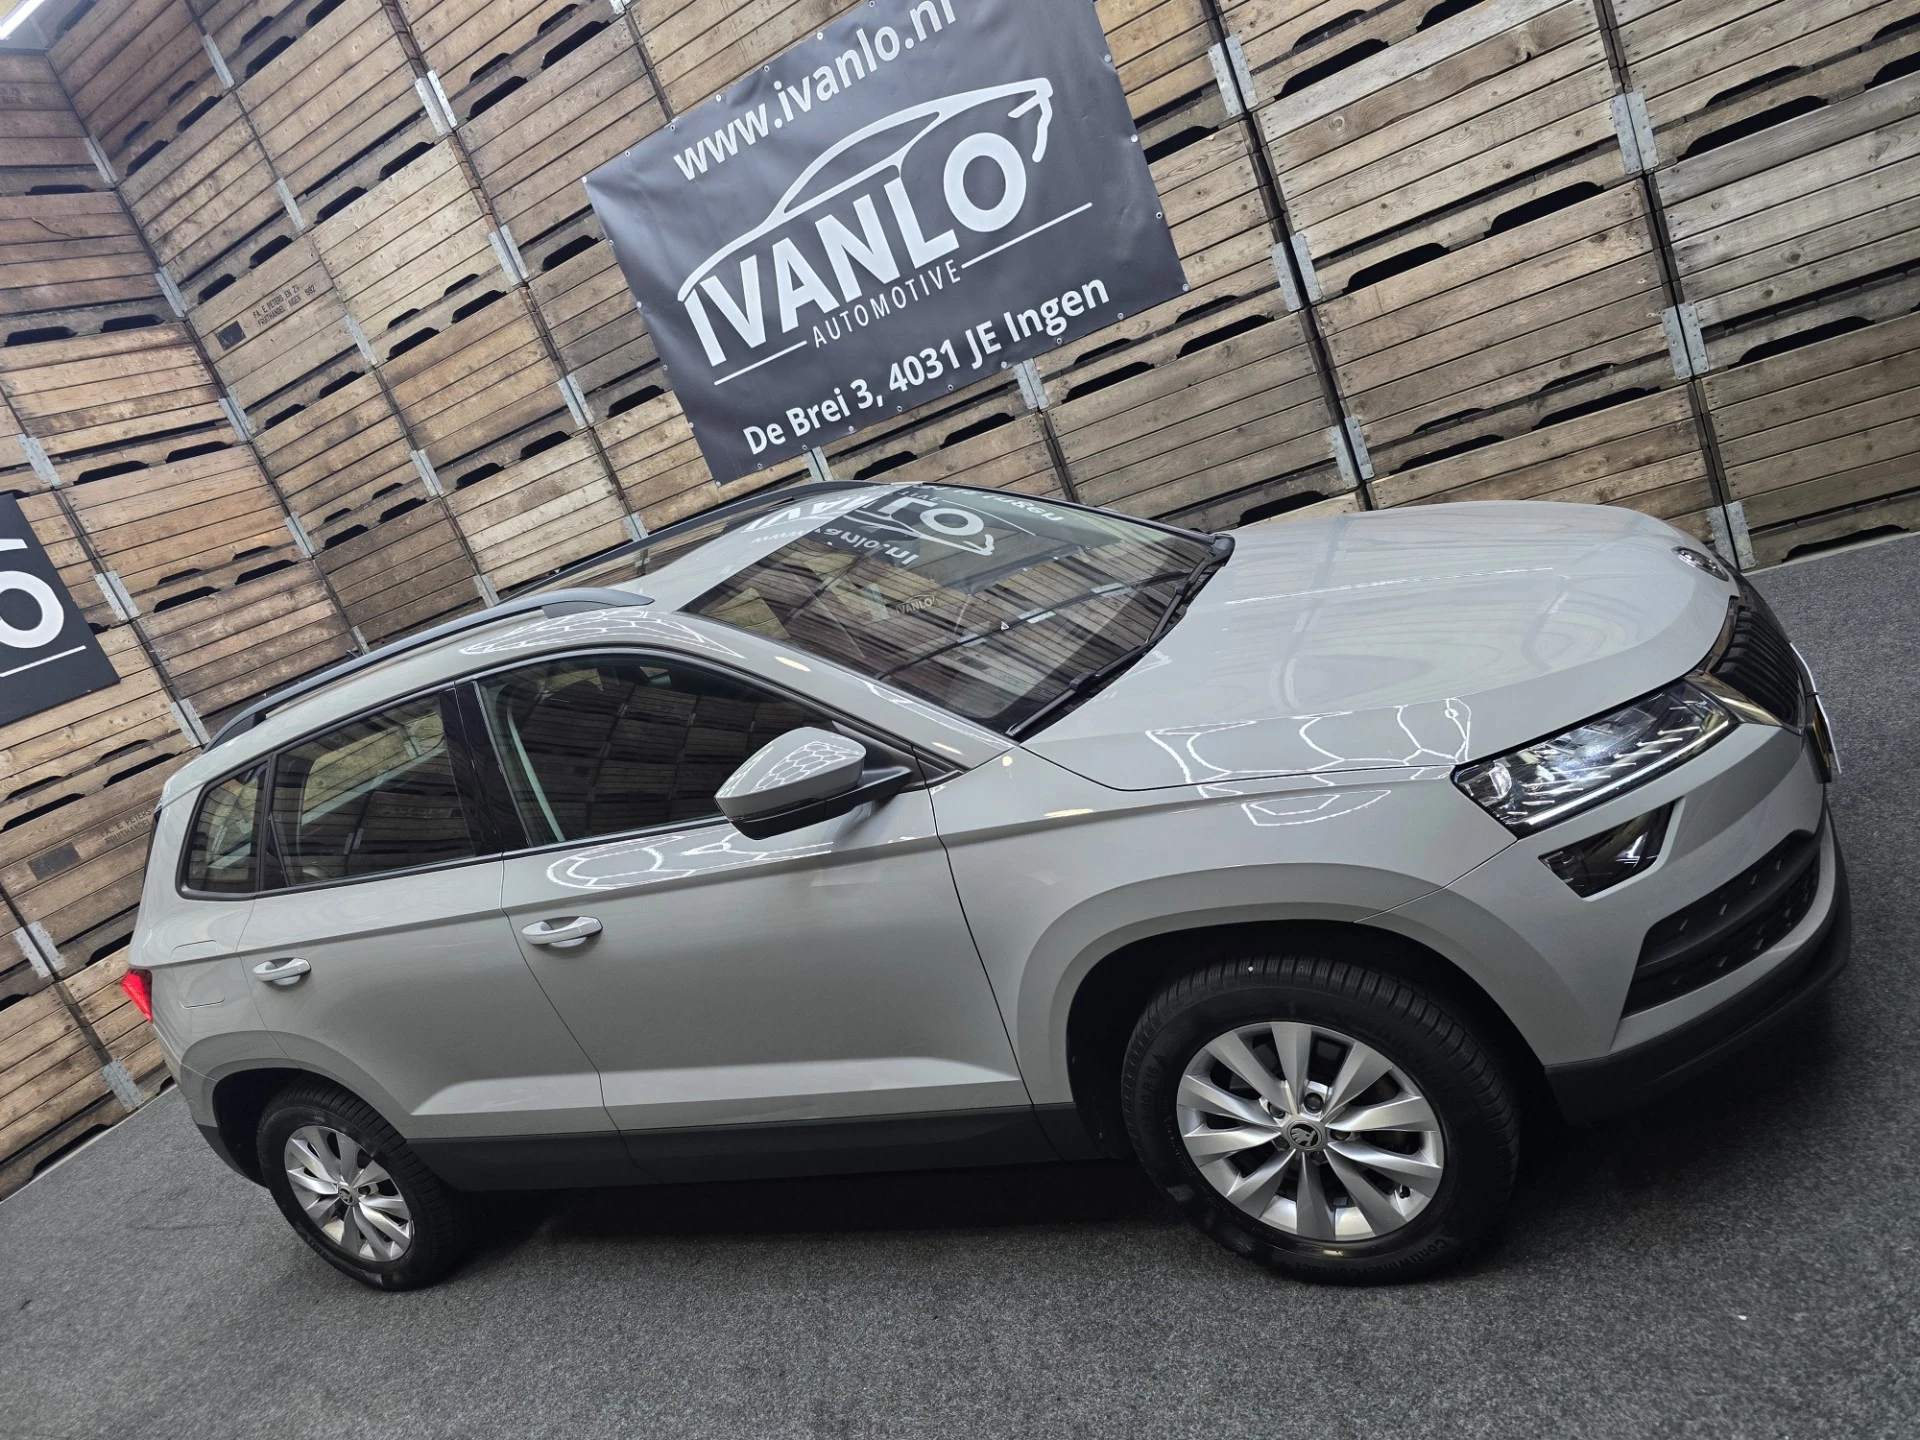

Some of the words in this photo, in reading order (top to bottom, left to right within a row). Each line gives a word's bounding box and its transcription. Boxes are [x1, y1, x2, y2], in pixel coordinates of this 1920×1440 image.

[683, 132, 1027, 367] IVANLO
[812, 260, 961, 349] AUTOMOTIVE
[743, 424, 786, 455] De
[786, 388, 851, 437] Brei
[850, 379, 884, 410] 3,
[889, 339, 961, 392] 4031
[965, 320, 1002, 369] JE
[1003, 279, 1110, 338] Ingen
